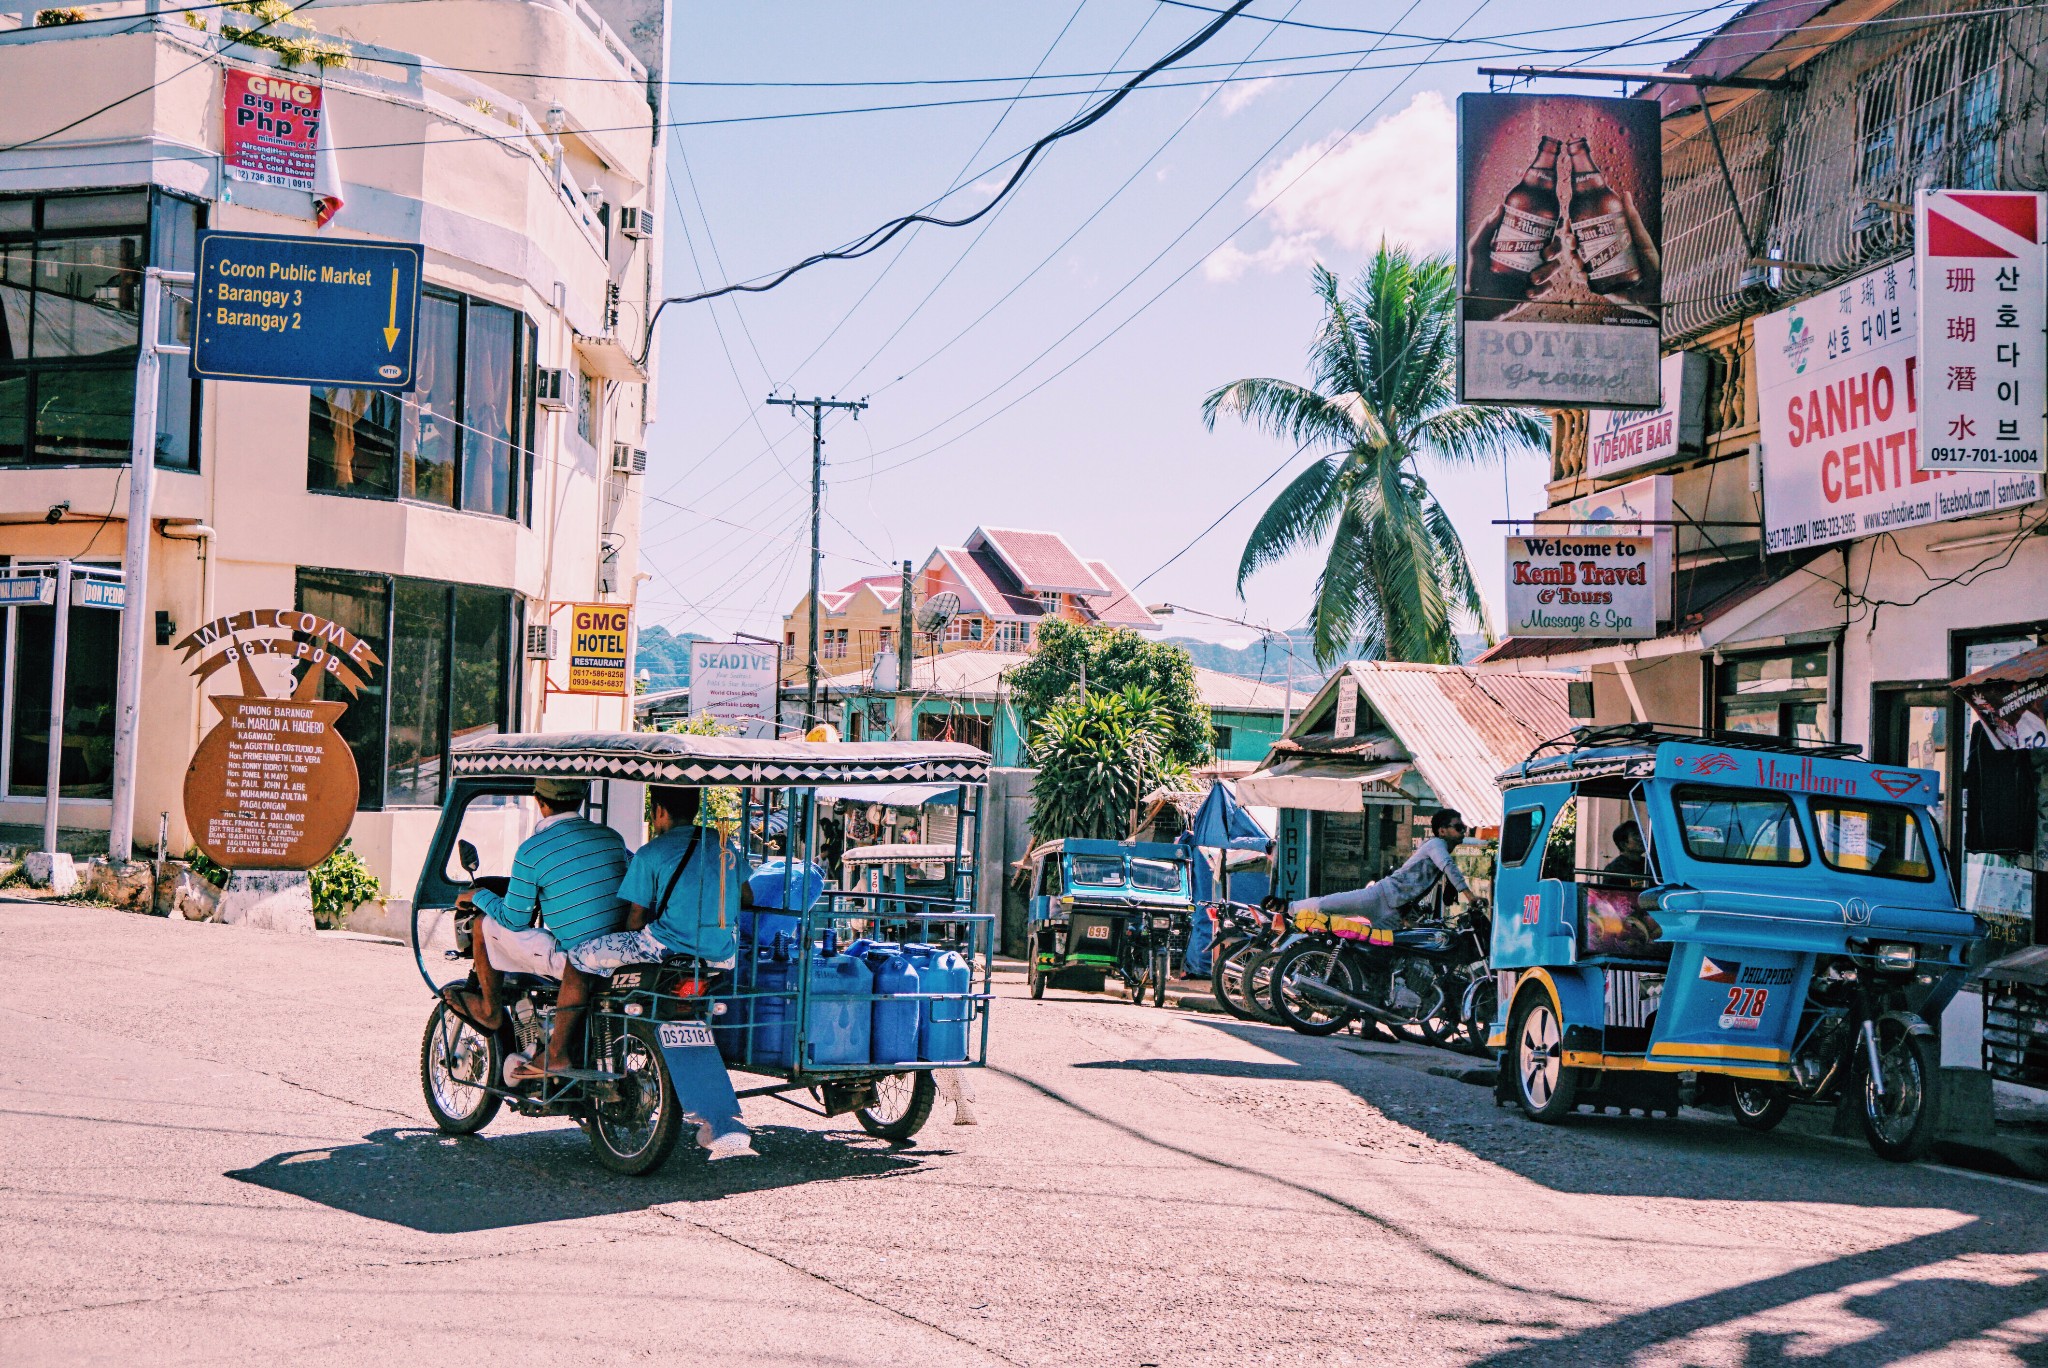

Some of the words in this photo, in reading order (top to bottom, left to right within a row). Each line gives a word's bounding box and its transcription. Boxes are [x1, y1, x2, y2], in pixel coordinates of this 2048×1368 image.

[247, 76, 312, 104] GMG
[243, 94, 274, 113] Big
[237, 107, 292, 137] Php
[258, 135, 296, 147] minimum
[241, 159, 256, 168] Hot
[265, 164, 283, 172] Cold
[260, 154, 285, 164] Coffee
[251, 171, 265, 181] 736
[267, 174, 286, 185] 3187
[1577, 229, 1598, 242] San
[1495, 240, 1514, 252] Pale
[1514, 241, 1545, 252] Pilsen
[219, 259, 265, 278] Coron
[270, 262, 317, 282] Public
[320, 266, 372, 287] Market
[218, 283, 289, 308] Barangay
[293, 290, 302, 306] 3
[217, 308, 288, 333] Barangay
[292, 313, 301, 329] 2
[1827, 324, 1852, 360] 산호
[1861, 305, 1902, 347] 다이브
[1477, 329, 1645, 361] BOTTL
[1787, 365, 1895, 448] SANHO
[1593, 426, 1643, 467] VDEOKE
[1646, 417, 1673, 452] BAR
[1931, 447, 2038, 464] 0917-701-1004
[1863, 500, 1932, 530] www.sanhodive.com
[1938, 487, 1992, 515] facebook.com
[1996, 474, 2037, 504] sanhodive
[1524, 539, 1611, 557] Welcome
[1615, 540, 1637, 557] to
[1512, 561, 1577, 585] KemB
[1579, 561, 1647, 585] Travel
[86, 583, 103, 602] DON
[1537, 588, 1555, 605] &
[1556, 587, 1612, 605] Tours
[576, 612, 626, 632] GMG
[1521, 608, 1586, 632] Massage
[1588, 611, 1600, 628] &
[1604, 608, 1633, 632] Spa
[193, 608, 371, 662] WELCOME
[577, 633, 624, 653] HOTEL
[296, 642, 341, 677] POB.
[574, 657, 624, 667] RESTAURANT
[699, 652, 771, 671] SEADIVE
[239, 704, 272, 716] PUNONG
[274, 707, 315, 719] BARANGAY
[231, 717, 246, 729] Hon.
[247, 718, 280, 731] MARLON
[282, 721, 291, 732] A.
[244, 742, 274, 751] AGUSTIN
[241, 762, 261, 770] SONNY
[262, 763, 283, 771] ISIDRO
[290, 764, 308, 773] YONG
[295, 754, 303, 763] DE
[304, 755, 321, 764] VERA
[241, 780, 259, 788] PAUL
[263, 780, 280, 789] JOHN
[292, 783, 306, 791] ABE
[1757, 757, 1858, 796] Marlboro
[239, 800, 287, 810] PAGALONGAN
[240, 790, 279, 799] MUHAMMAD
[280, 792, 307, 802] SULTAN
[1521, 894, 1541, 925] 278
[611, 972, 642, 986] 175
[1741, 966, 1797, 985] PHILIPPINES
[1723, 986, 1769, 1018] 278
